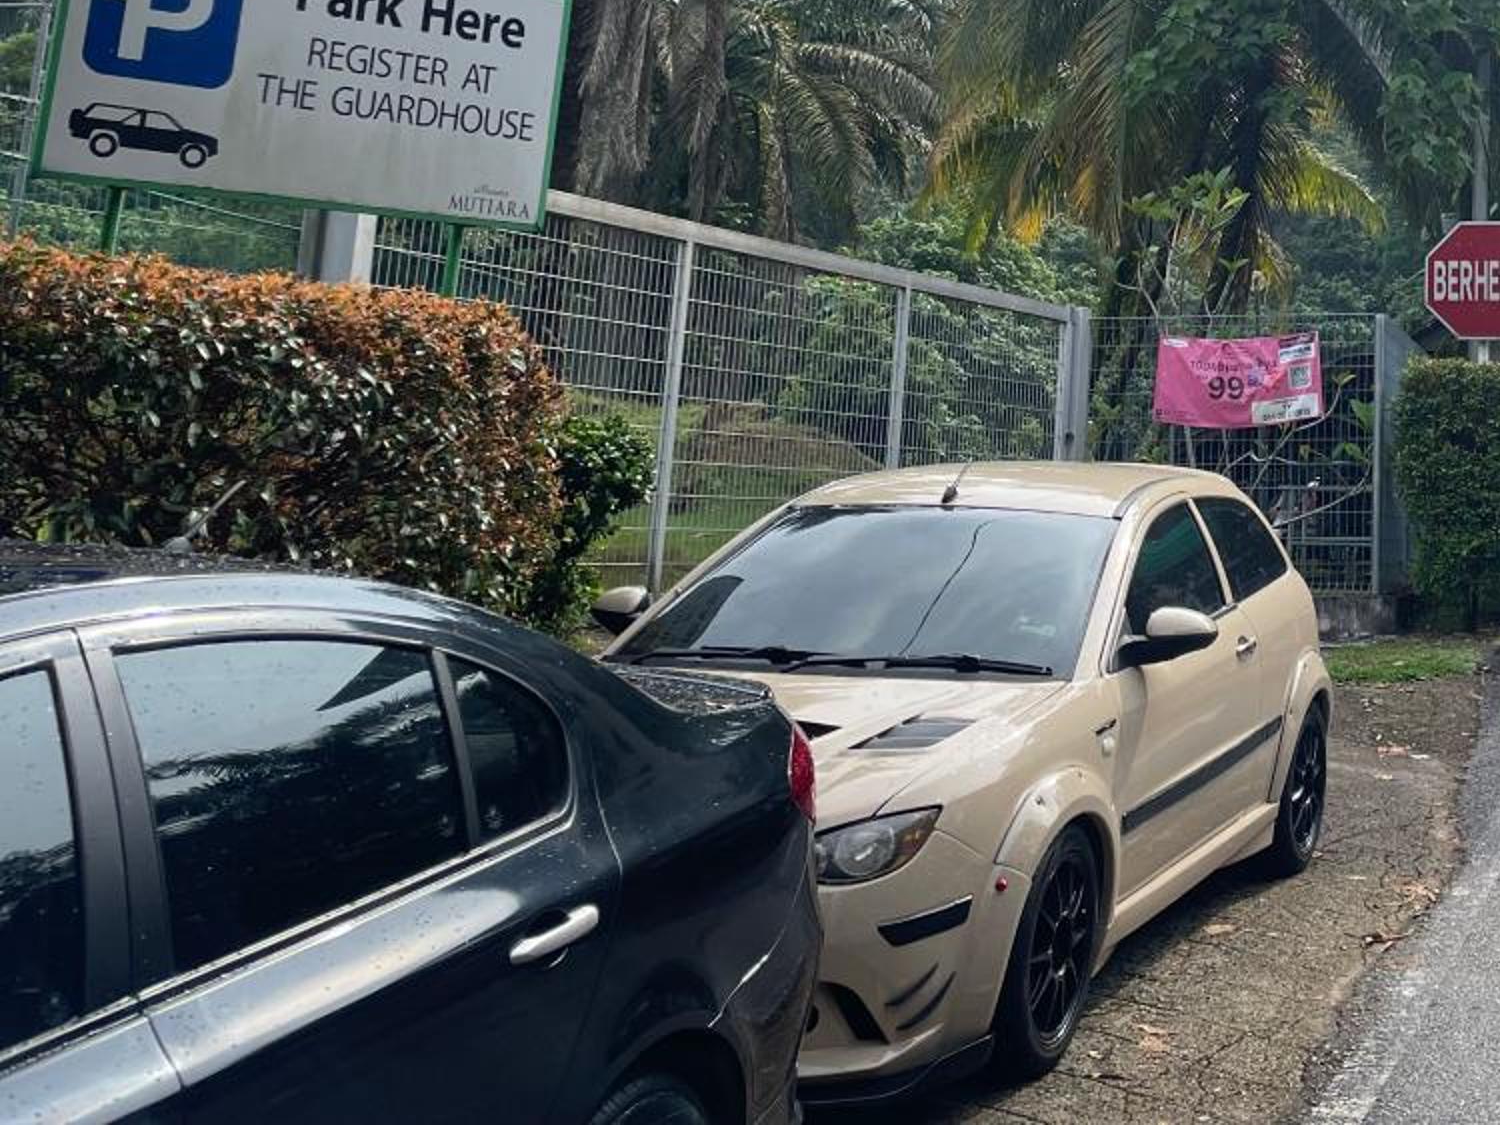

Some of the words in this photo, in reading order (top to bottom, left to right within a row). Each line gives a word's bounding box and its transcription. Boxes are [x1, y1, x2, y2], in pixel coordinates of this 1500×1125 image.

[307, 37, 448, 87] REGISTER
[461, 63, 498, 94] AT
[256, 73, 319, 111] THE
[331, 85, 537, 142] GUARDHOUSE
[447, 195, 530, 220] MUTIARA
[1208, 375, 1245, 400] 99
